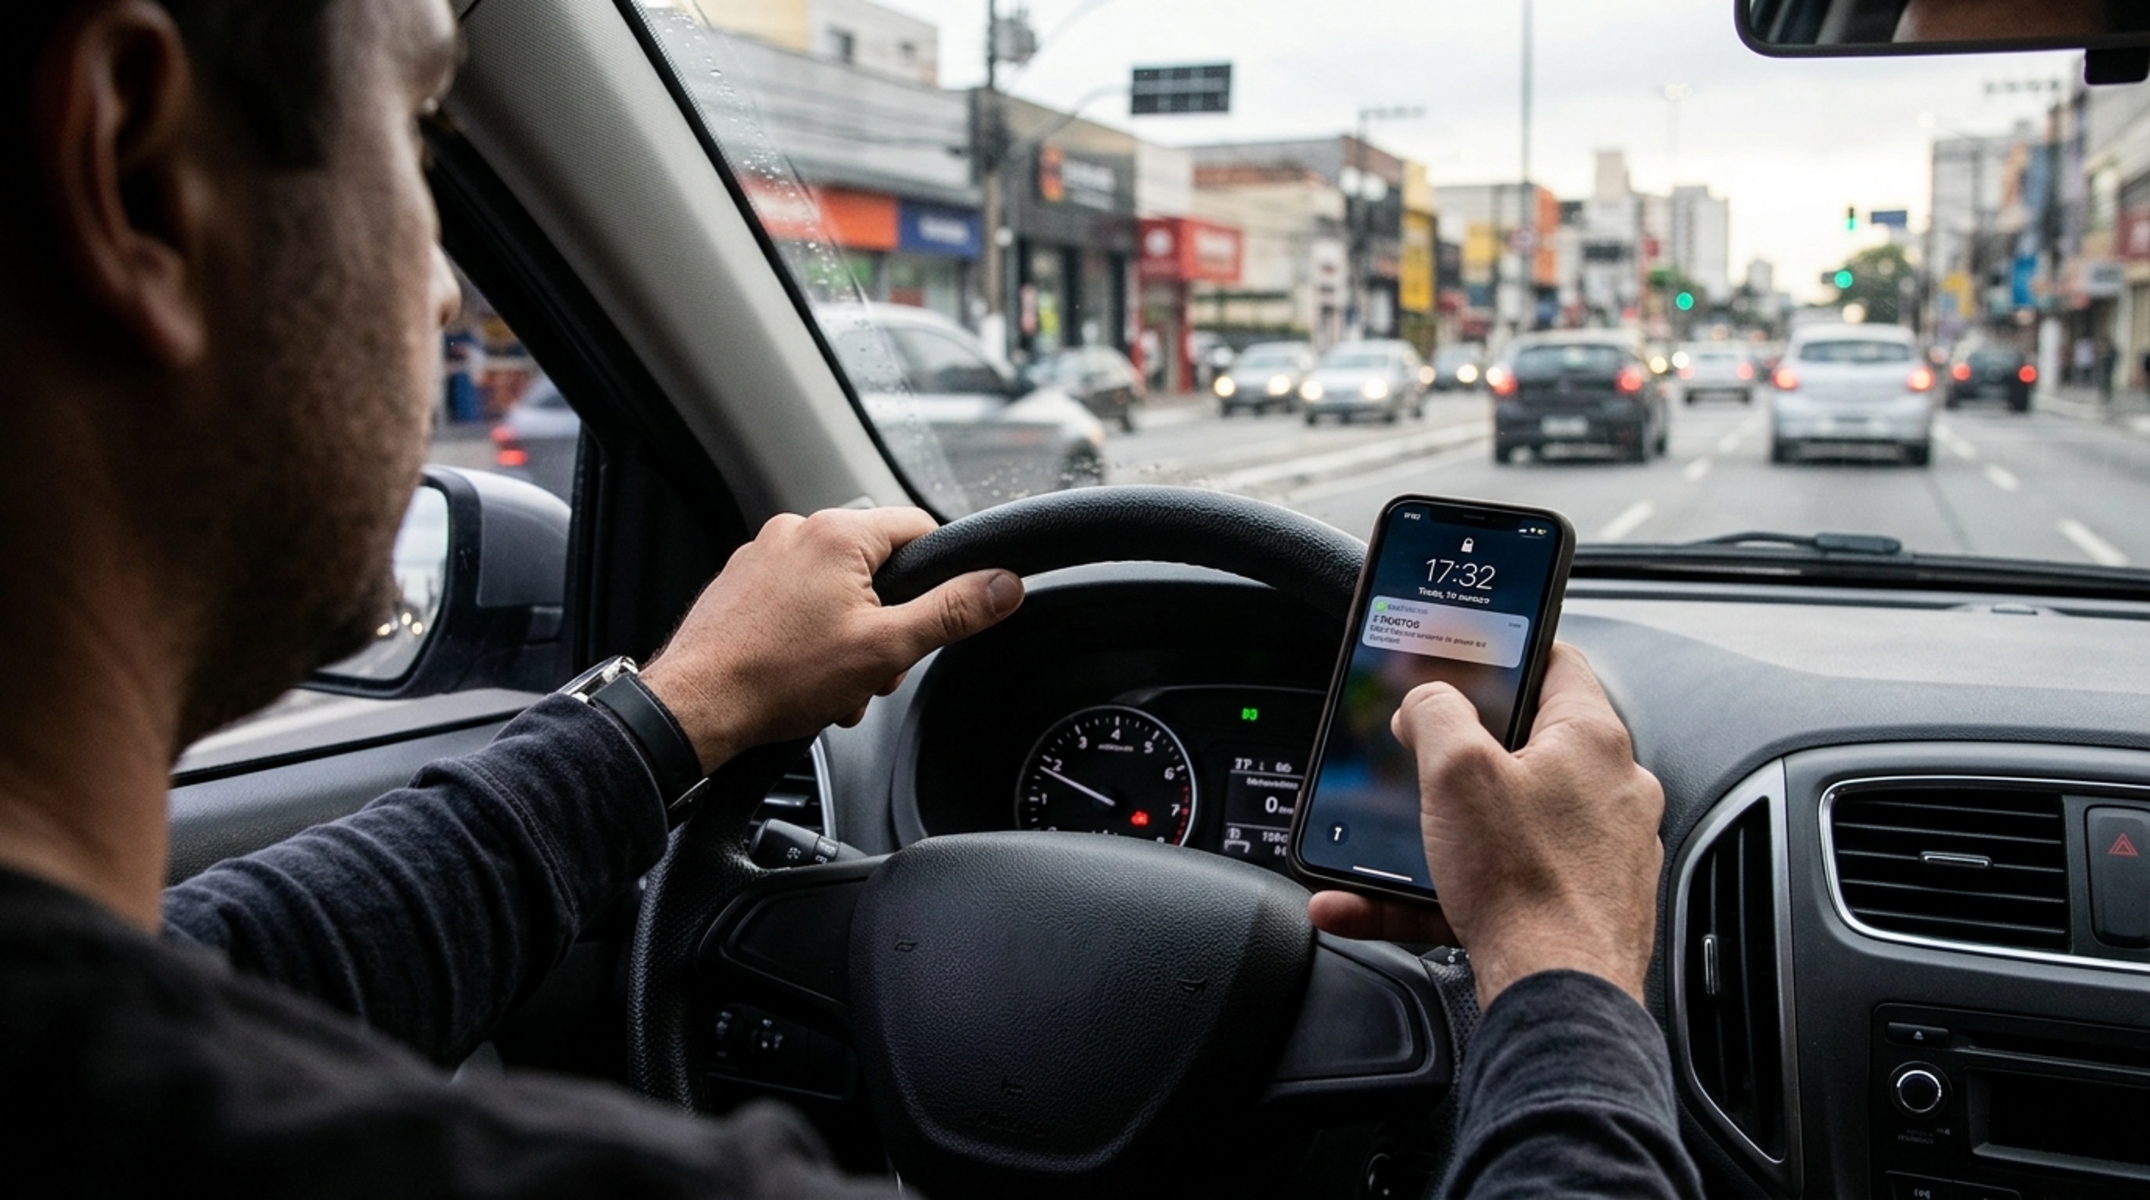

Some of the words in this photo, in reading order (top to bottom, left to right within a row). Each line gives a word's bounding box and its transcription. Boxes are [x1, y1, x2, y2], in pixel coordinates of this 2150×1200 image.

[1426, 558, 1496, 590] 17:32
[1110, 728, 1121, 741] 4
[1078, 736, 1088, 749] 3
[1144, 741, 1154, 754] 5
[1052, 759, 1063, 772] 2
[1164, 767, 1175, 780] 6
[1171, 804, 1181, 817] 7
[1264, 796, 1279, 813] 0
